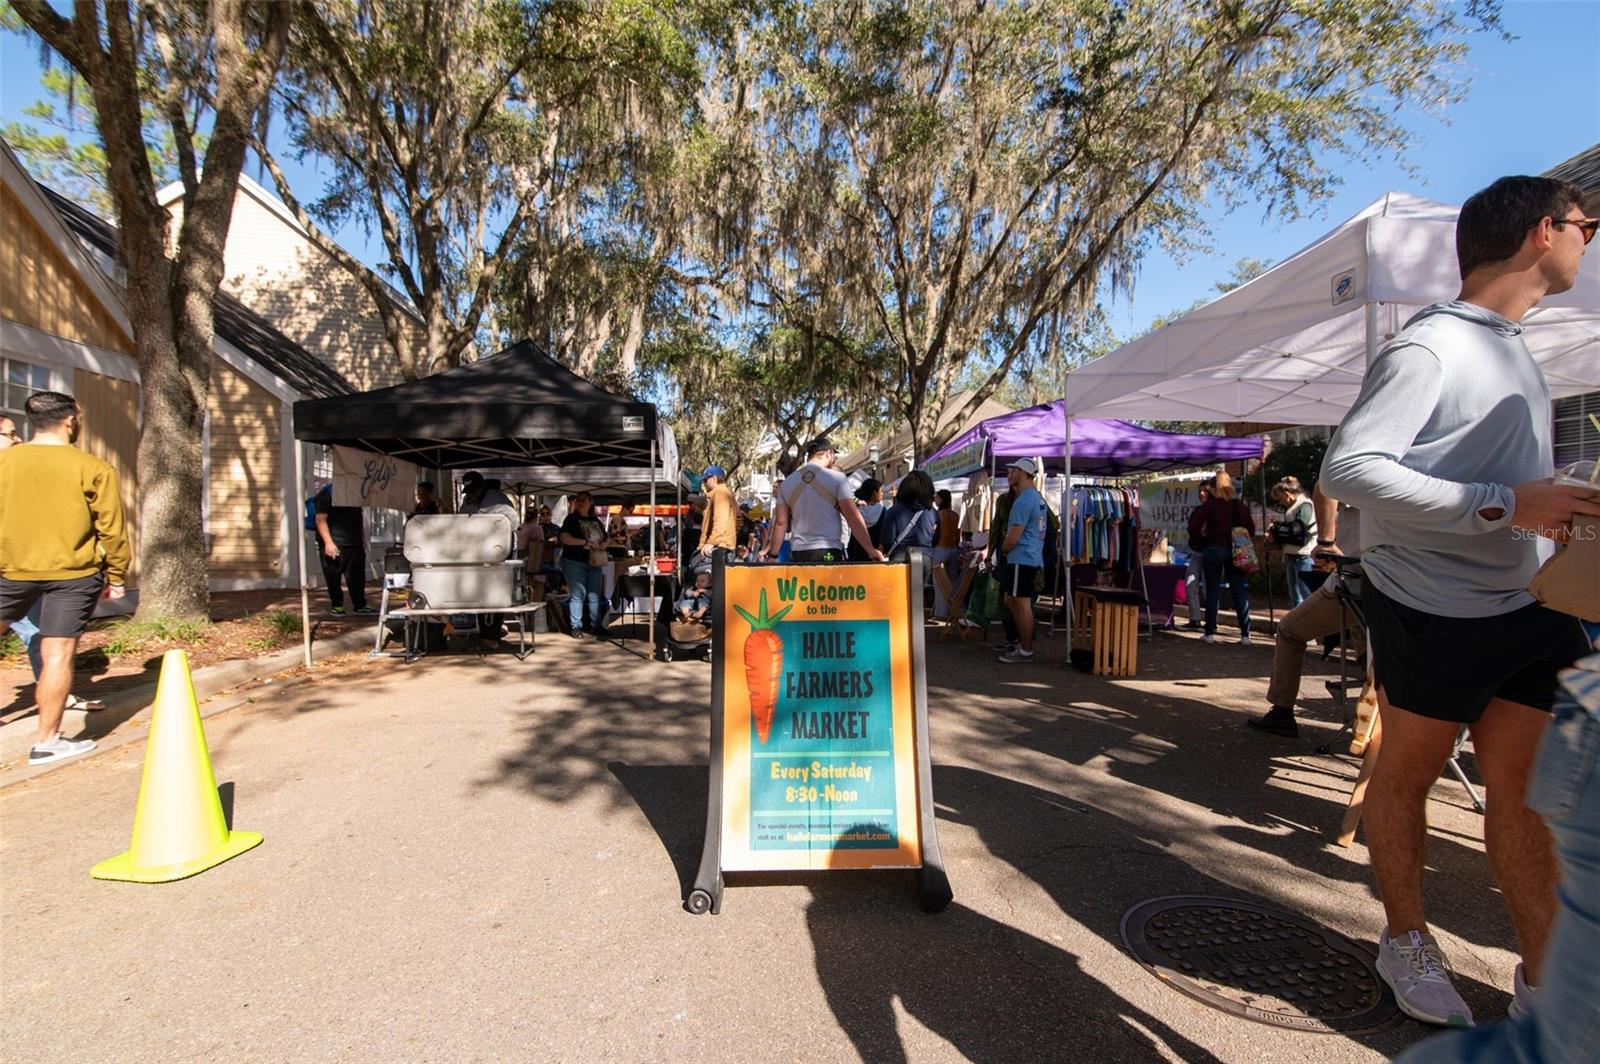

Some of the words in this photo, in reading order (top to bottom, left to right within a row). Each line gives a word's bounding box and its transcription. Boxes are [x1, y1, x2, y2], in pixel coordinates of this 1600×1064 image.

[776, 576, 866, 602] Welcome
[807, 605, 818, 615] to
[821, 604, 837, 615] the
[802, 631, 857, 659] HAILE
[785, 670, 874, 699] FARMERS
[791, 711, 870, 739] MARKET
[770, 761, 809, 782] Every
[811, 760, 872, 782] Saturday
